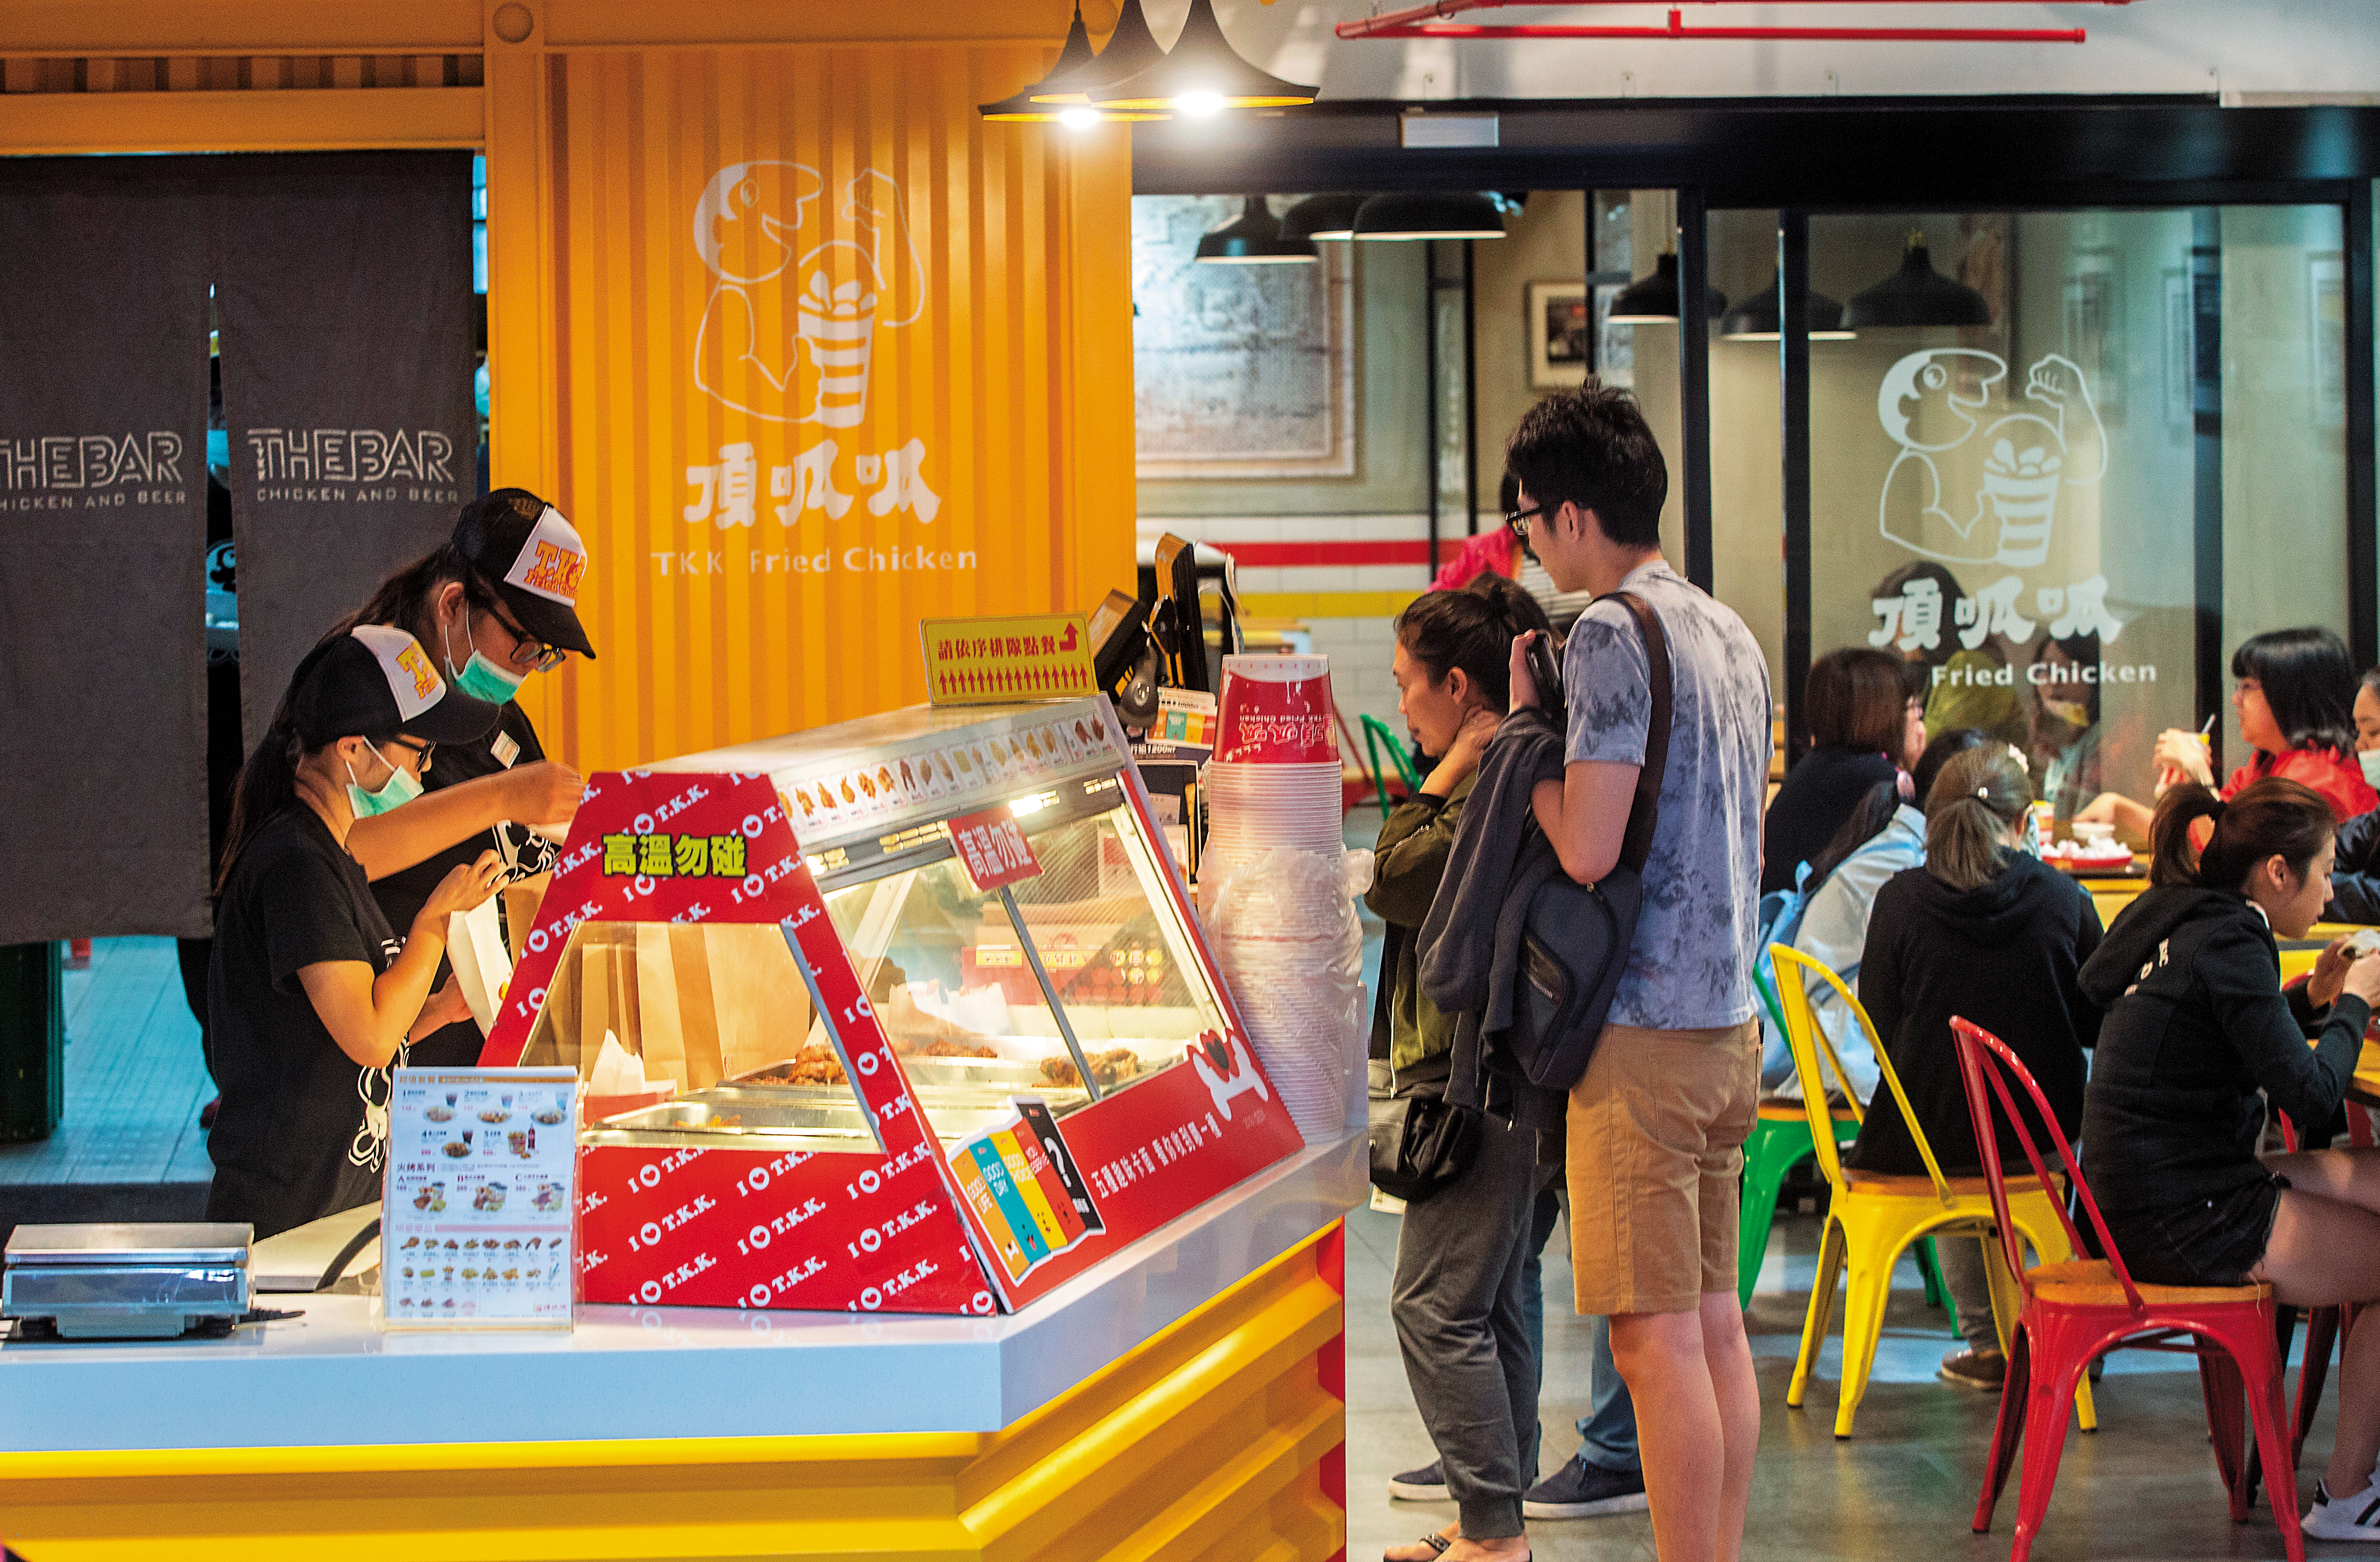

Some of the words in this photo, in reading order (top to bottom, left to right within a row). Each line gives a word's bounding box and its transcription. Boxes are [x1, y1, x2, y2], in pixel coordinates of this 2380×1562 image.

[0, 495, 73, 511] HICKEN
[85, 494, 126, 509] AND
[137, 490, 186, 505] BEER
[257, 488, 345, 502] CHICKEN
[356, 488, 397, 503] AND
[409, 488, 458, 503] BEER
[683, 437, 942, 530] 頂呱呱
[651, 550, 723, 576] TKK
[750, 548, 830, 574] Fried
[842, 545, 976, 572] Chicken
[1868, 574, 2123, 652] 頂呱呱
[1932, 663, 2014, 687] Fried
[2027, 661, 2157, 685] Chicken
[656, 785, 709, 822] T.K.K.
[603, 834, 746, 877] 高溫勿碰
[958, 816, 1033, 880] 高溫勿碰
[983, 1161, 1004, 1183] GOOD
[1002, 1152, 1024, 1170] GOOD
[629, 1236, 640, 1252] I
[662, 1194, 716, 1231] T.K.K.
[737, 1239, 749, 1255] I
[771, 1197, 826, 1235] T.K.K.
[848, 1242, 859, 1258] I
[882, 1200, 937, 1238] T.K.K.
[663, 1253, 717, 1289] T.K.K.
[959, 1245, 971, 1262] I
[772, 1256, 827, 1293] T.K.K.
[883, 1259, 938, 1295] T.K.K.
